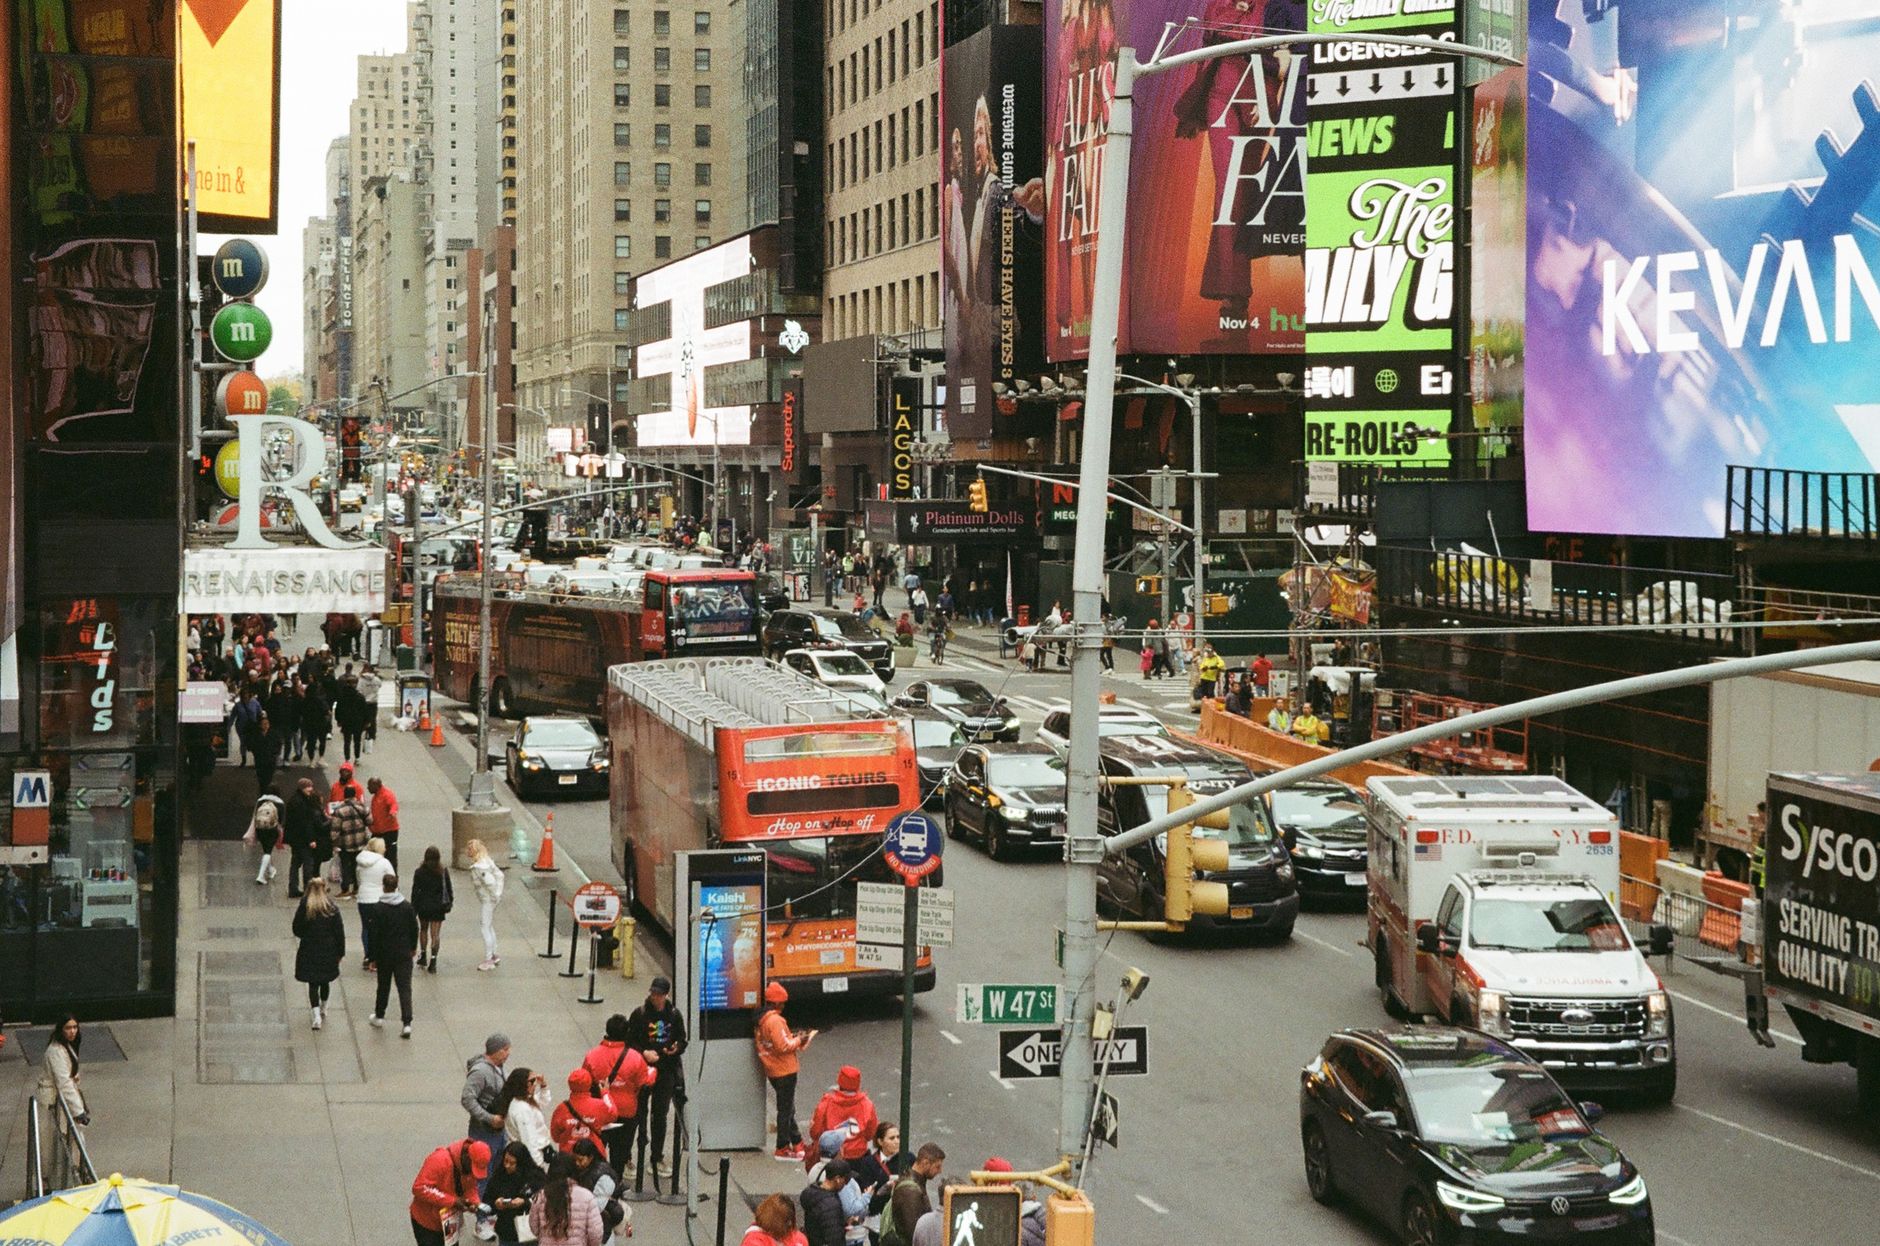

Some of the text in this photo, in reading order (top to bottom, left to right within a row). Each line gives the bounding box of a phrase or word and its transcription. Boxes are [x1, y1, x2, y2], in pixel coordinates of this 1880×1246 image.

[1002, 84, 1015, 149] WESTSIDE
[1306, 115, 1395, 157] NEWS
[216, 166, 232, 193] in
[235, 166, 246, 195] &
[1002, 152, 1014, 189] GUNN
[1350, 177, 1453, 259] The
[1001, 208, 1014, 265] HEELS
[222, 258, 243, 277] m
[341, 236, 353, 327] WELLINGTON
[1001, 268, 1014, 315] HAVE
[230, 322, 256, 341] m
[1220, 317, 1247, 329] Nov
[1250, 317, 1260, 329] 4
[1001, 317, 1014, 364] EYES
[1001, 368, 1014, 379] 3
[243, 390, 262, 409] m
[895, 394, 911, 490] LAGOS
[224, 415, 375, 549] R
[926, 511, 1024, 525] Platinum Dolls
[990, 527, 1006, 535] Sports
[183, 569, 385, 595] RENAISSANCE
[91, 622, 115, 732] Lids
[727, 770, 737, 780] 15
[903, 760, 912, 768] 15
[757, 771, 887, 792] ICONIC TOURS
[768, 815, 875, 835] Hop on Hop off
[734, 855, 762, 863] LinkNYC
[1586, 845, 1613, 855] 2638
[889, 855, 937, 874] NO STANDING
[920, 929, 929, 937] Top
[1779, 898, 1880, 963] SERVING TR
[1778, 940, 1872, 1003] QUALITY TO
[989, 991, 1052, 1018] W 47 St
[1023, 1045, 1062, 1063] ONE
